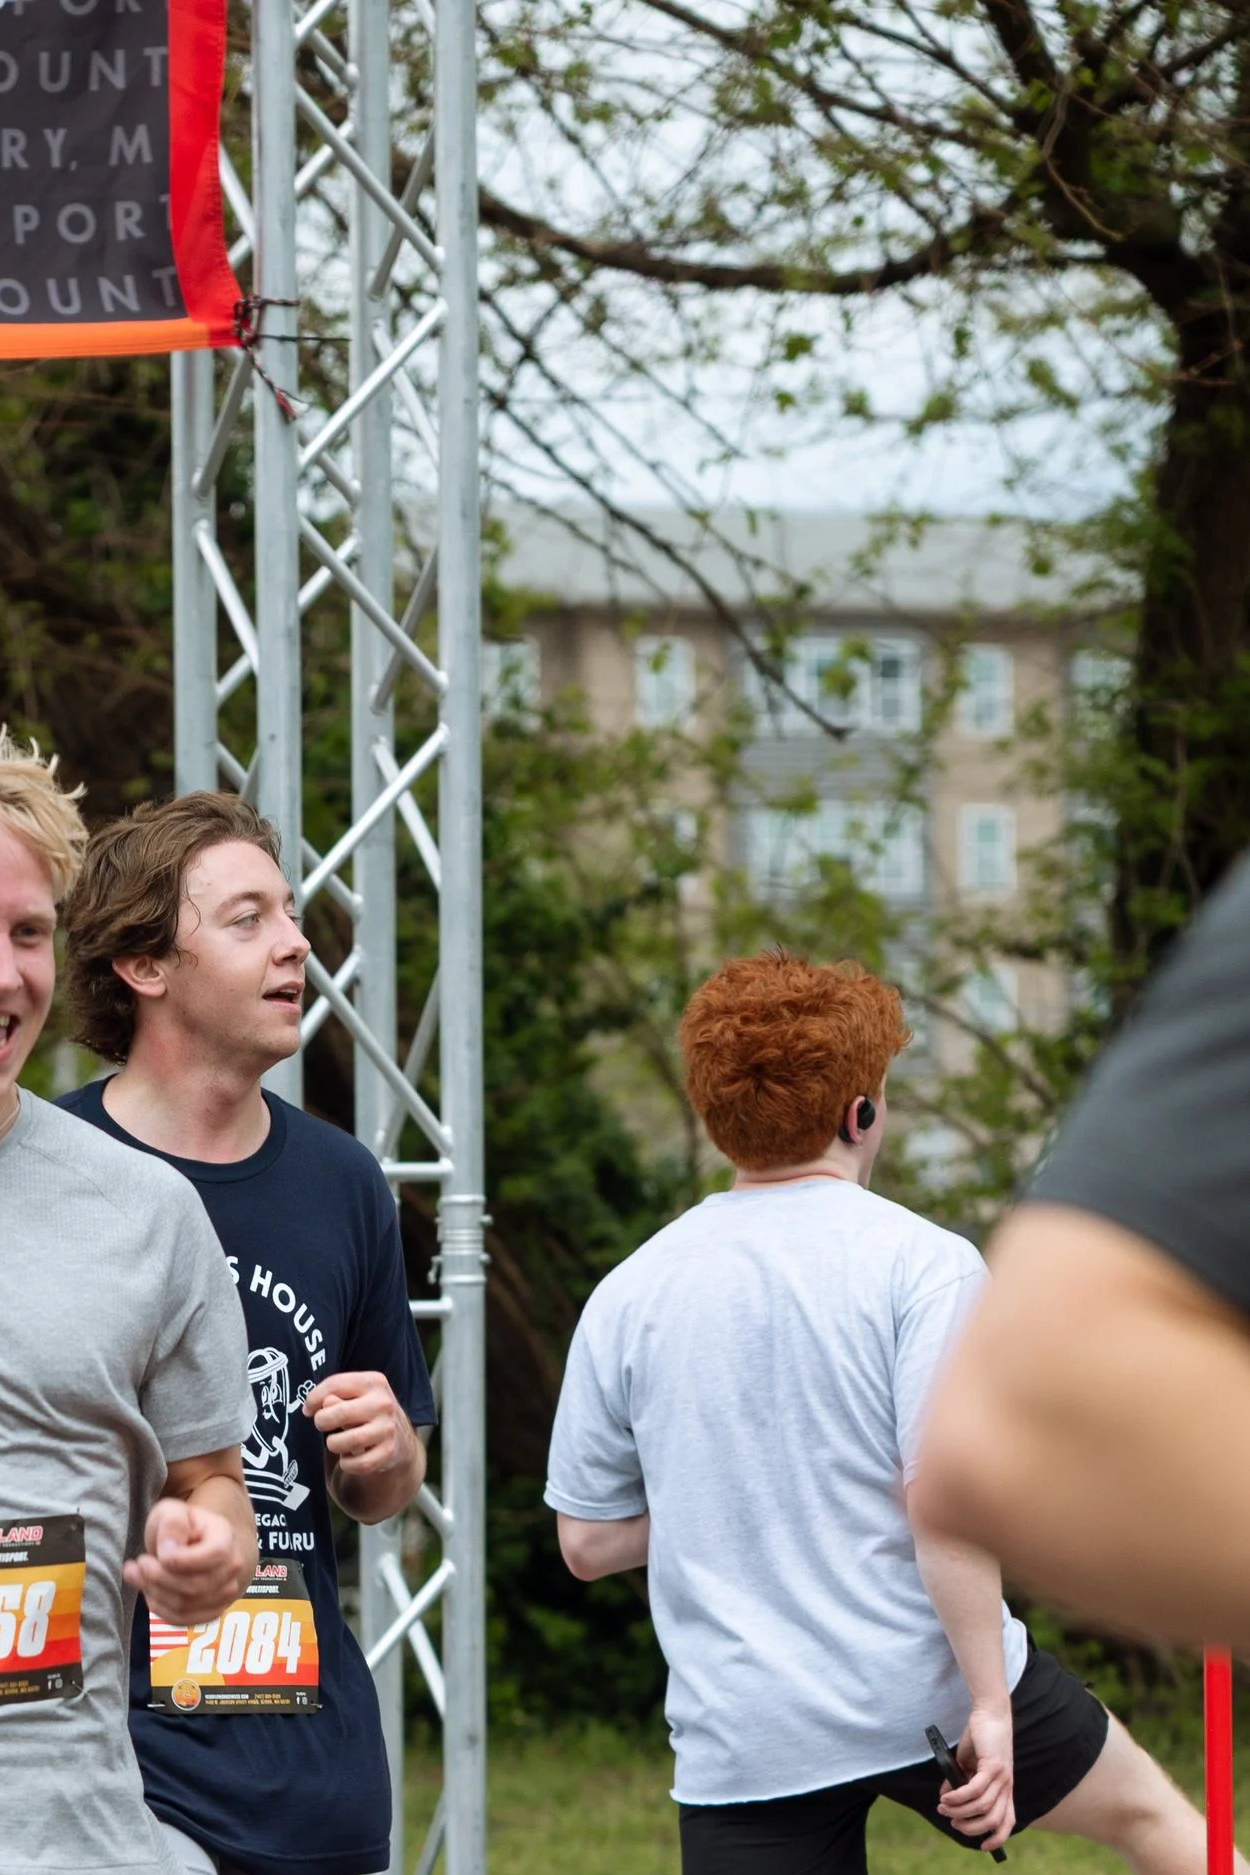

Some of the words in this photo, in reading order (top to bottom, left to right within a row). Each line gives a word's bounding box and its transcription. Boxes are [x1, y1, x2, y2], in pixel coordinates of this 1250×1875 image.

[109, 123, 153, 166] M
[250, 1264, 326, 1371] HOUSE
[186, 1610, 302, 1675] 2084
